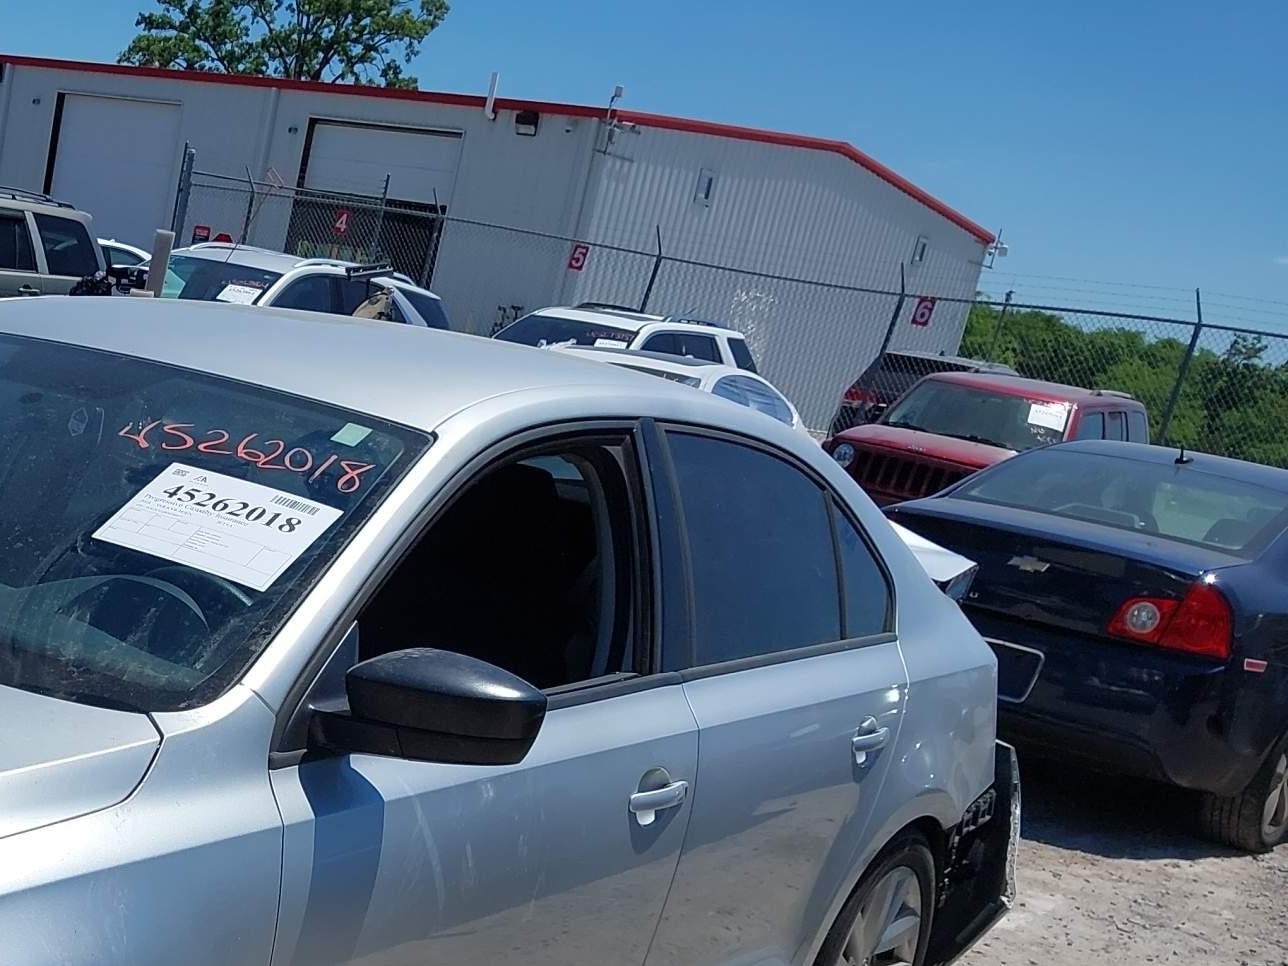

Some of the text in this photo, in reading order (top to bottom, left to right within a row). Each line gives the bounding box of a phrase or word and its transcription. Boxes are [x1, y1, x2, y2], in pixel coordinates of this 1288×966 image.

[335, 212, 348, 233] 4
[570, 248, 586, 268] 5
[915, 301, 933, 322] 6
[118, 420, 377, 493] 45262018
[162, 484, 302, 534] 45262018
